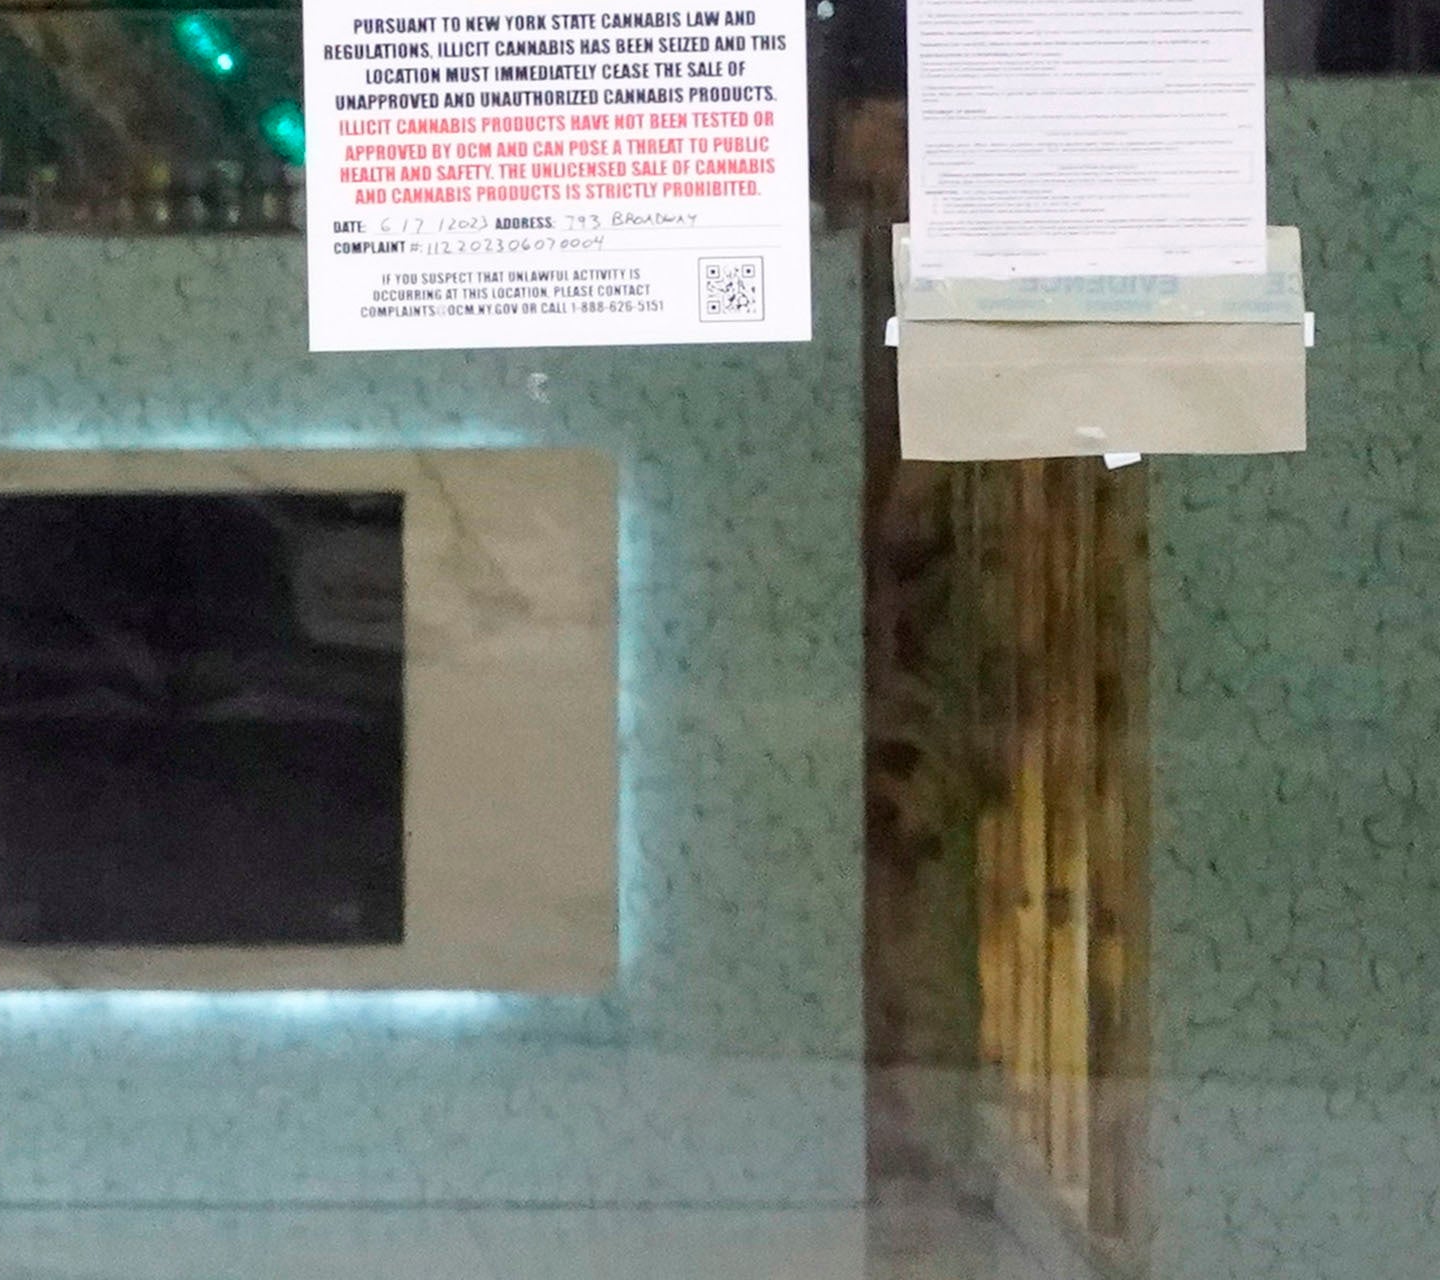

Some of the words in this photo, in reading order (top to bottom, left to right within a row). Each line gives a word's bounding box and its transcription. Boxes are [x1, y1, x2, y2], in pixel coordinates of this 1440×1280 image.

[353, 16, 437, 34] PURSUANT
[441, 16, 460, 32] TO
[465, 15, 500, 32] NEW
[505, 14, 546, 31] YORK
[551, 13, 595, 30] STATE
[601, 11, 681, 29] CANNABIS
[686, 10, 719, 27] LAW
[724, 10, 755, 26] AND
[437, 40, 490, 58] ILLICIT
[494, 38, 575, 56] CANNABIS
[580, 38, 610, 54] HAS
[615, 37, 653, 54] BEEN
[658, 36, 709, 53] SEIZED
[714, 35, 745, 51] AND
[750, 34, 786, 51] THIS
[366, 67, 440, 84] LOCATION
[445, 66, 489, 83] MUST
[494, 64, 596, 82] IMMEDIATELY
[601, 62, 649, 79] CEASE
[654, 62, 682, 78] THE
[687, 61, 722, 77] SALE
[727, 60, 745, 76] OF
[335, 92, 439, 110] UNAPPROVED
[443, 92, 475, 108] AND
[480, 89, 598, 107] UNAUTHORIZED
[603, 87, 683, 104] CANNABIS
[688, 85, 776, 103] PRODUCTS.
[339, 118, 391, 136] ILLICIT
[396, 116, 476, 135] CANNABIS
[481, 114, 565, 133] PRODUCTS
[570, 114, 609, 131] HAVE
[614, 113, 644, 130] NOT
[649, 112, 687, 129] BEEN
[691, 110, 748, 128] TESTED
[753, 110, 774, 127] OR
[344, 143, 427, 161] APPROVED
[431, 143, 451, 159] BY
[456, 142, 492, 159] OCM
[496, 141, 528, 158] AND
[532, 140, 564, 157] CAN
[568, 139, 608, 156] POSE
[612, 139, 622, 155] A
[626, 137, 684, 155] THREAT
[688, 137, 708, 153] TO
[713, 135, 769, 153] PUBLIC
[339, 166, 395, 183] HEALTH
[399, 165, 432, 182] AND
[436, 163, 494, 181] SAFETY.
[498, 162, 526, 179] THE
[531, 160, 626, 179] UNLICENSED
[631, 159, 667, 176] SALE
[672, 159, 690, 175] OF
[695, 157, 775, 175] CANNABIS
[354, 187, 386, 204] AND
[391, 185, 472, 204] CANNABIS
[476, 183, 561, 202] PRODUCTS
[565, 183, 581, 200] IS
[585, 181, 658, 199] STRICTLY
[662, 179, 760, 198] PROHIBITED.
[333, 239, 405, 255] COMPLAINT
[382, 273, 390, 285] IF
[394, 273, 417, 285] YOU
[421, 271, 473, 285] SUSPECT
[476, 271, 503, 283] THAT
[508, 269, 568, 282] UNLAWFUL
[572, 268, 625, 281] ACTIVITY
[629, 268, 640, 280] IS
[372, 288, 442, 302] OCCURRING
[445, 288, 458, 300] AT
[462, 287, 488, 300] THIS
[553, 285, 593, 297] PLEASE
[597, 283, 650, 297] CONTACT
[521, 302, 537, 314] OR
[540, 301, 567, 314] CALL
